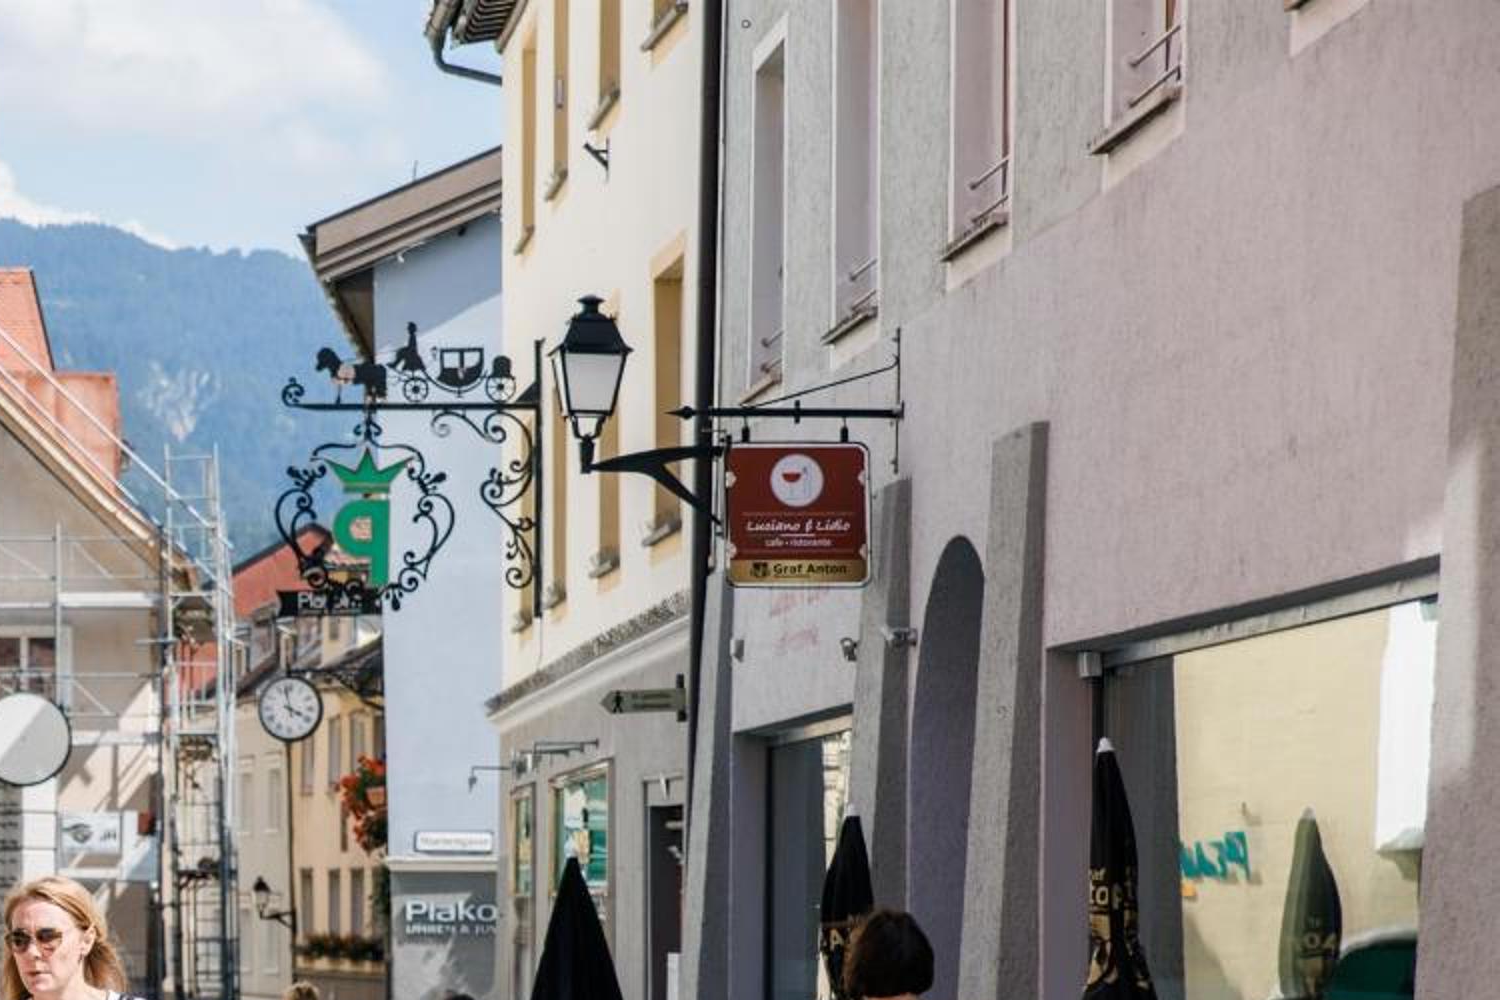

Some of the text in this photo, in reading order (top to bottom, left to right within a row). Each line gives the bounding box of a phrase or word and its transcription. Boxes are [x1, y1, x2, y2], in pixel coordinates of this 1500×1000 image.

[773, 562, 848, 577] Graf Anton
[405, 899, 497, 922] Plako
